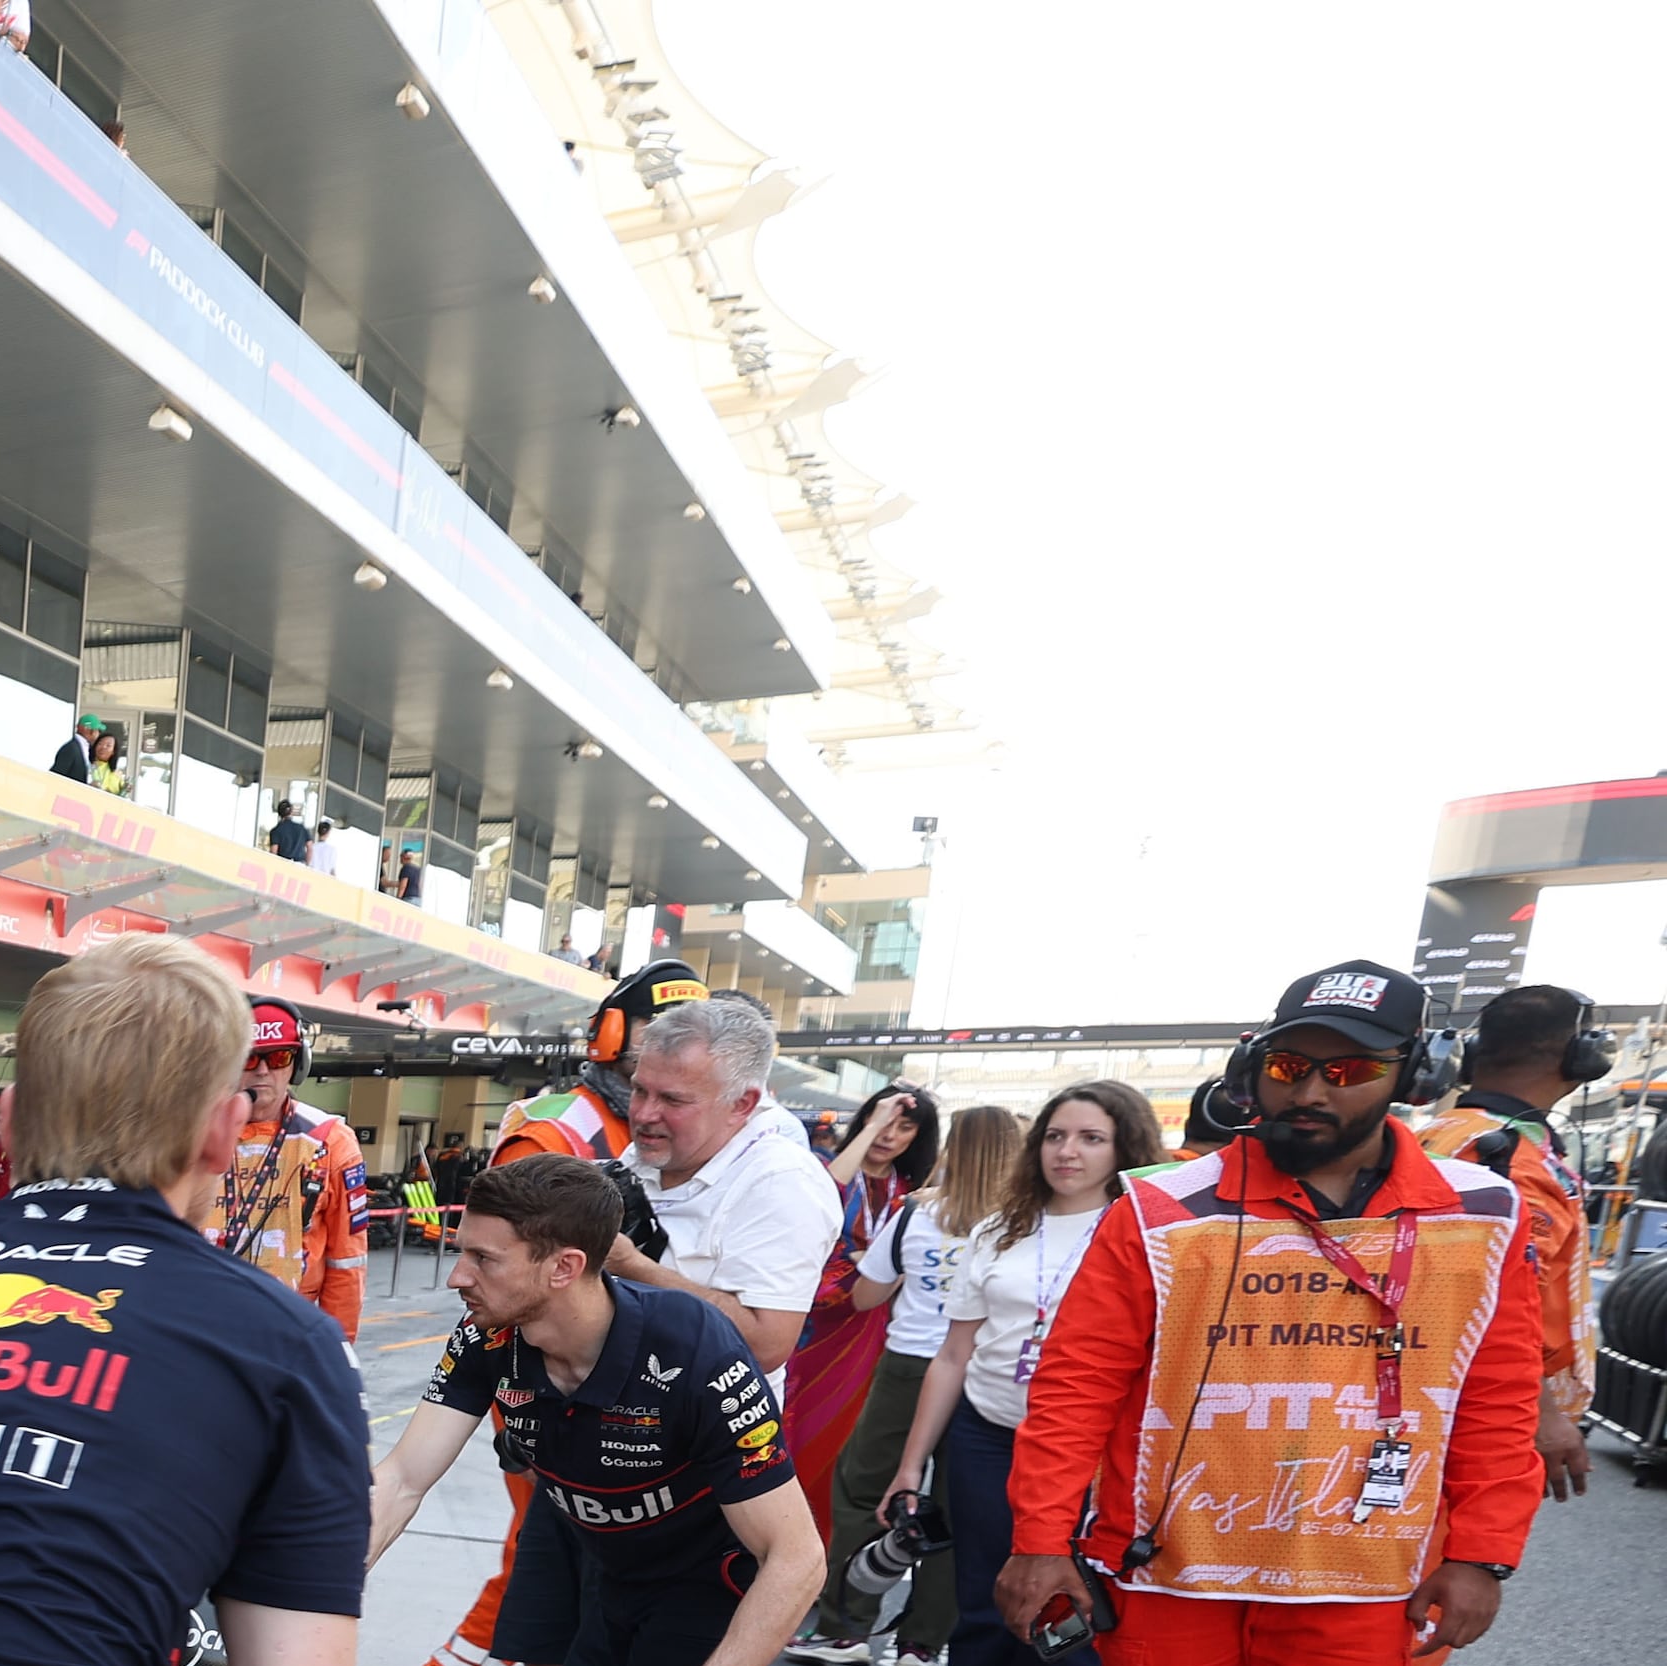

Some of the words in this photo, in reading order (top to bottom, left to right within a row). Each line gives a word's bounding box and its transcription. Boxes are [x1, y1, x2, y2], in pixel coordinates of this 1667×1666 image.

[150, 246, 227, 333] PADDOCK
[228, 322, 265, 368] CLUB
[1310, 986, 1379, 1001] GRID
[452, 1036, 524, 1055] CEVA
[1207, 1324, 1259, 1347] PIT
[707, 1360, 750, 1392] VISA
[739, 1378, 762, 1403] AT&T
[728, 1396, 771, 1433] ROKT
[1190, 1382, 1334, 1430] PIT
[601, 1440, 661, 1452] HONDA
[613, 1458, 663, 1468] Gate.io
[572, 1486, 675, 1524] Bull
[1259, 1567, 1294, 1586] FIA
